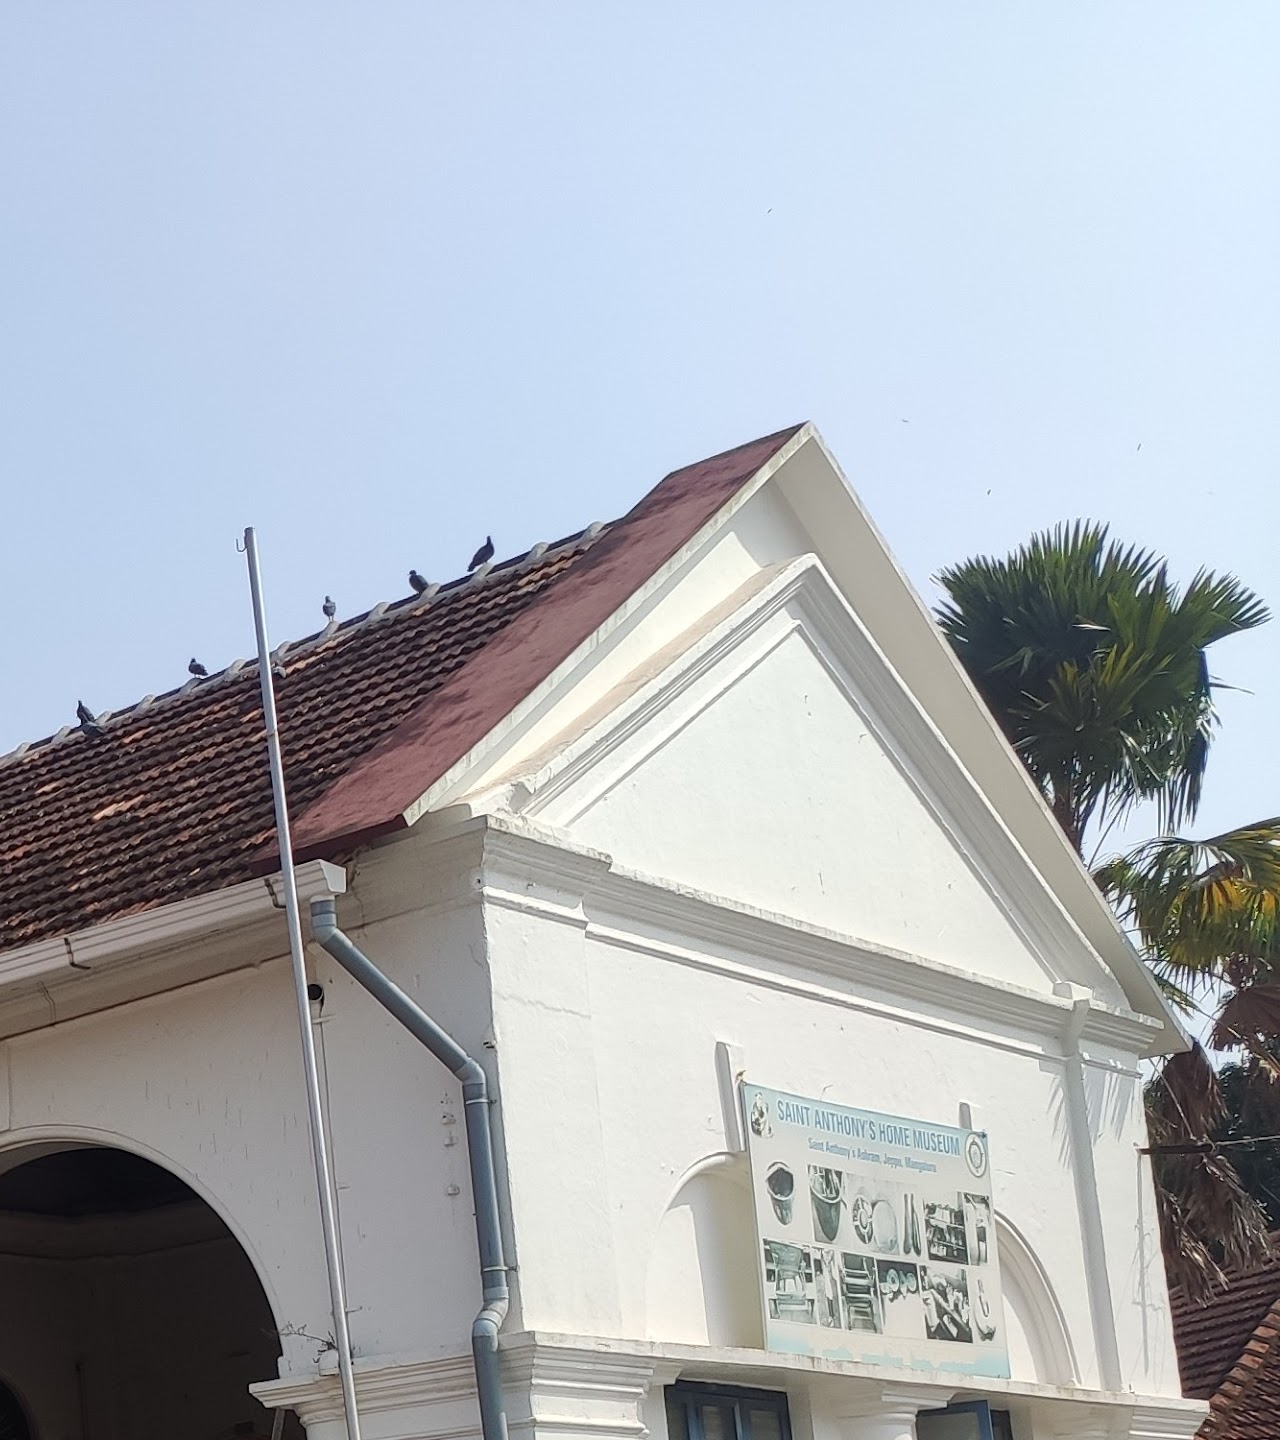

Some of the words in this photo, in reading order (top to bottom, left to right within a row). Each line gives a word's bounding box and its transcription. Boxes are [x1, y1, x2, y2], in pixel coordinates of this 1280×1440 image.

[776, 1099, 810, 1126] SAINT
[814, 1109, 876, 1140] ANTHONY'S
[879, 1123, 910, 1147] HOME
[912, 1129, 961, 1156] MUSEUM
